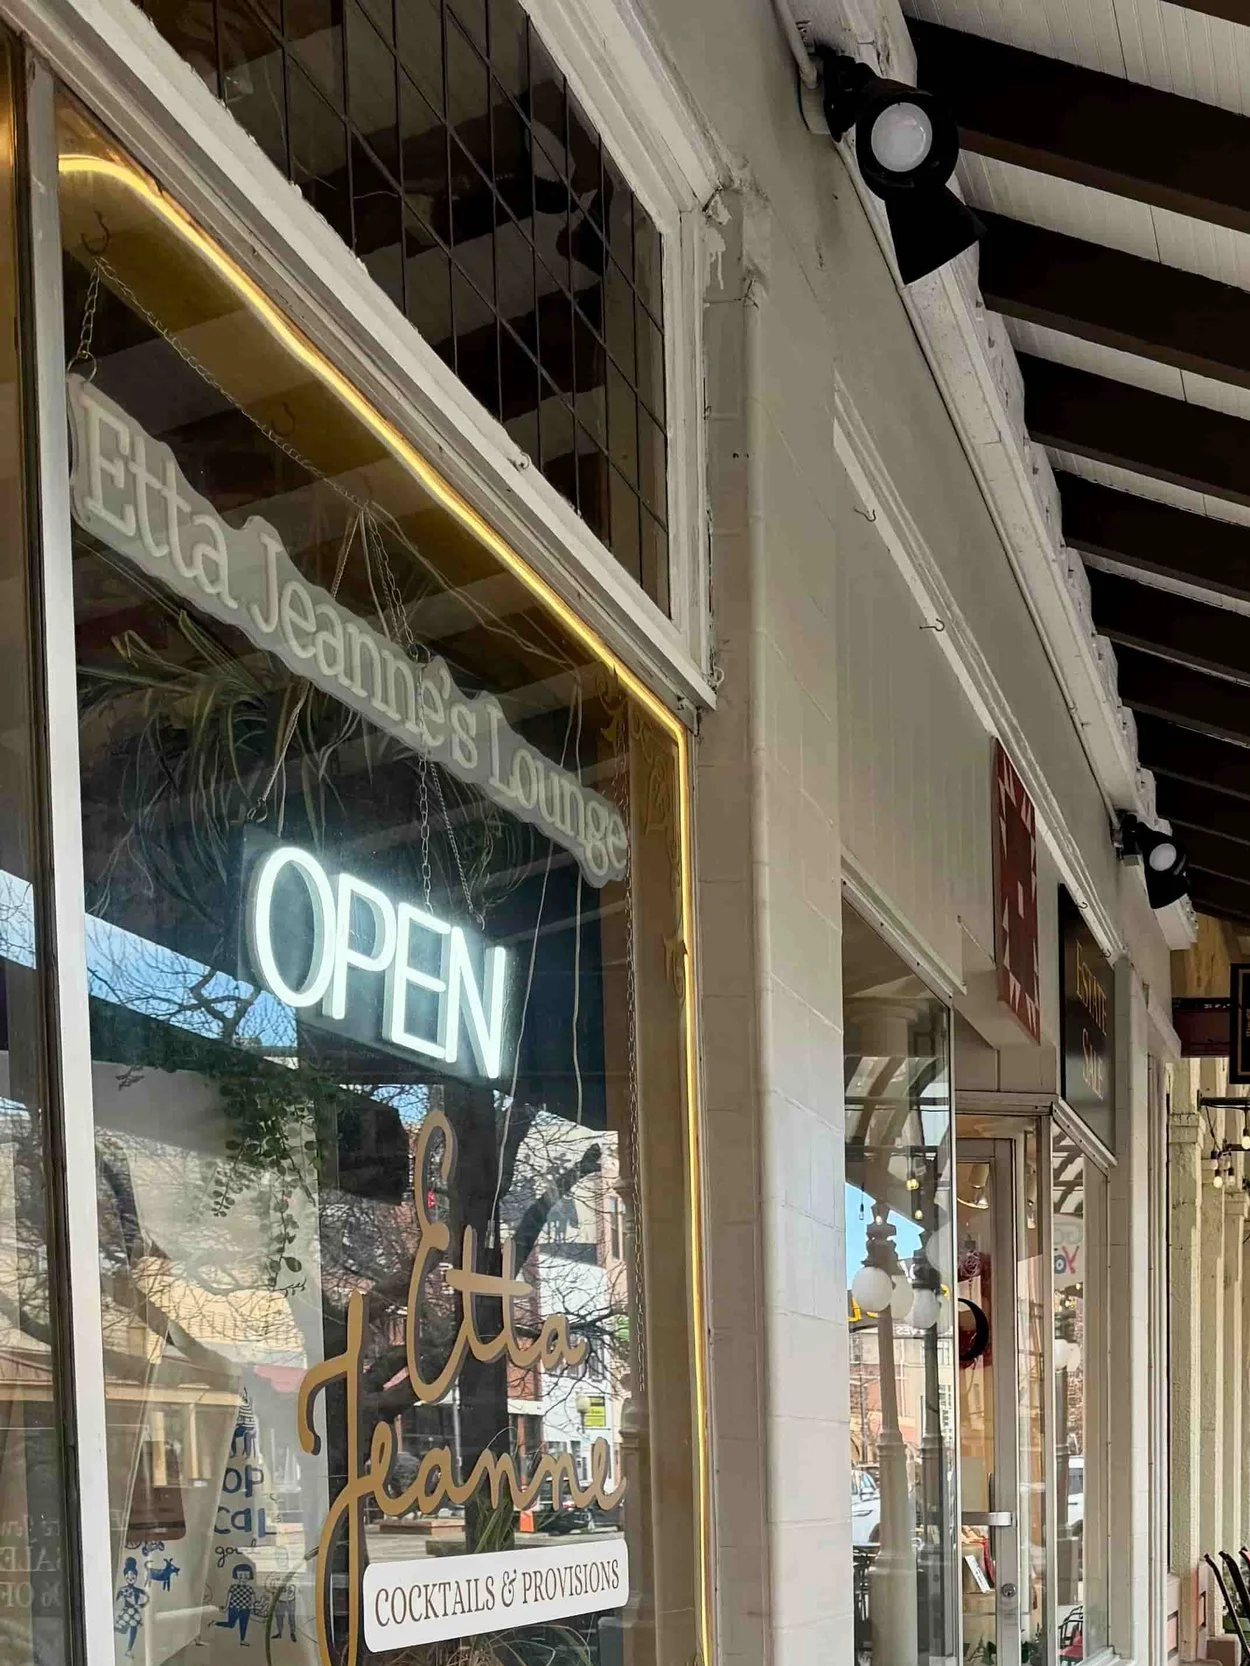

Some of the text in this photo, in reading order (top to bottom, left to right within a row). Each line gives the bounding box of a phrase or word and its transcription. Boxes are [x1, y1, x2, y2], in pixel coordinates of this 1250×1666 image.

[80, 393, 630, 876] Etta Jeanne's Lounge
[252, 845, 507, 1080] OPEN
[406, 1109, 588, 1403] Etta
[374, 1558, 620, 1628] COCKTAILS & PROVISIONS
